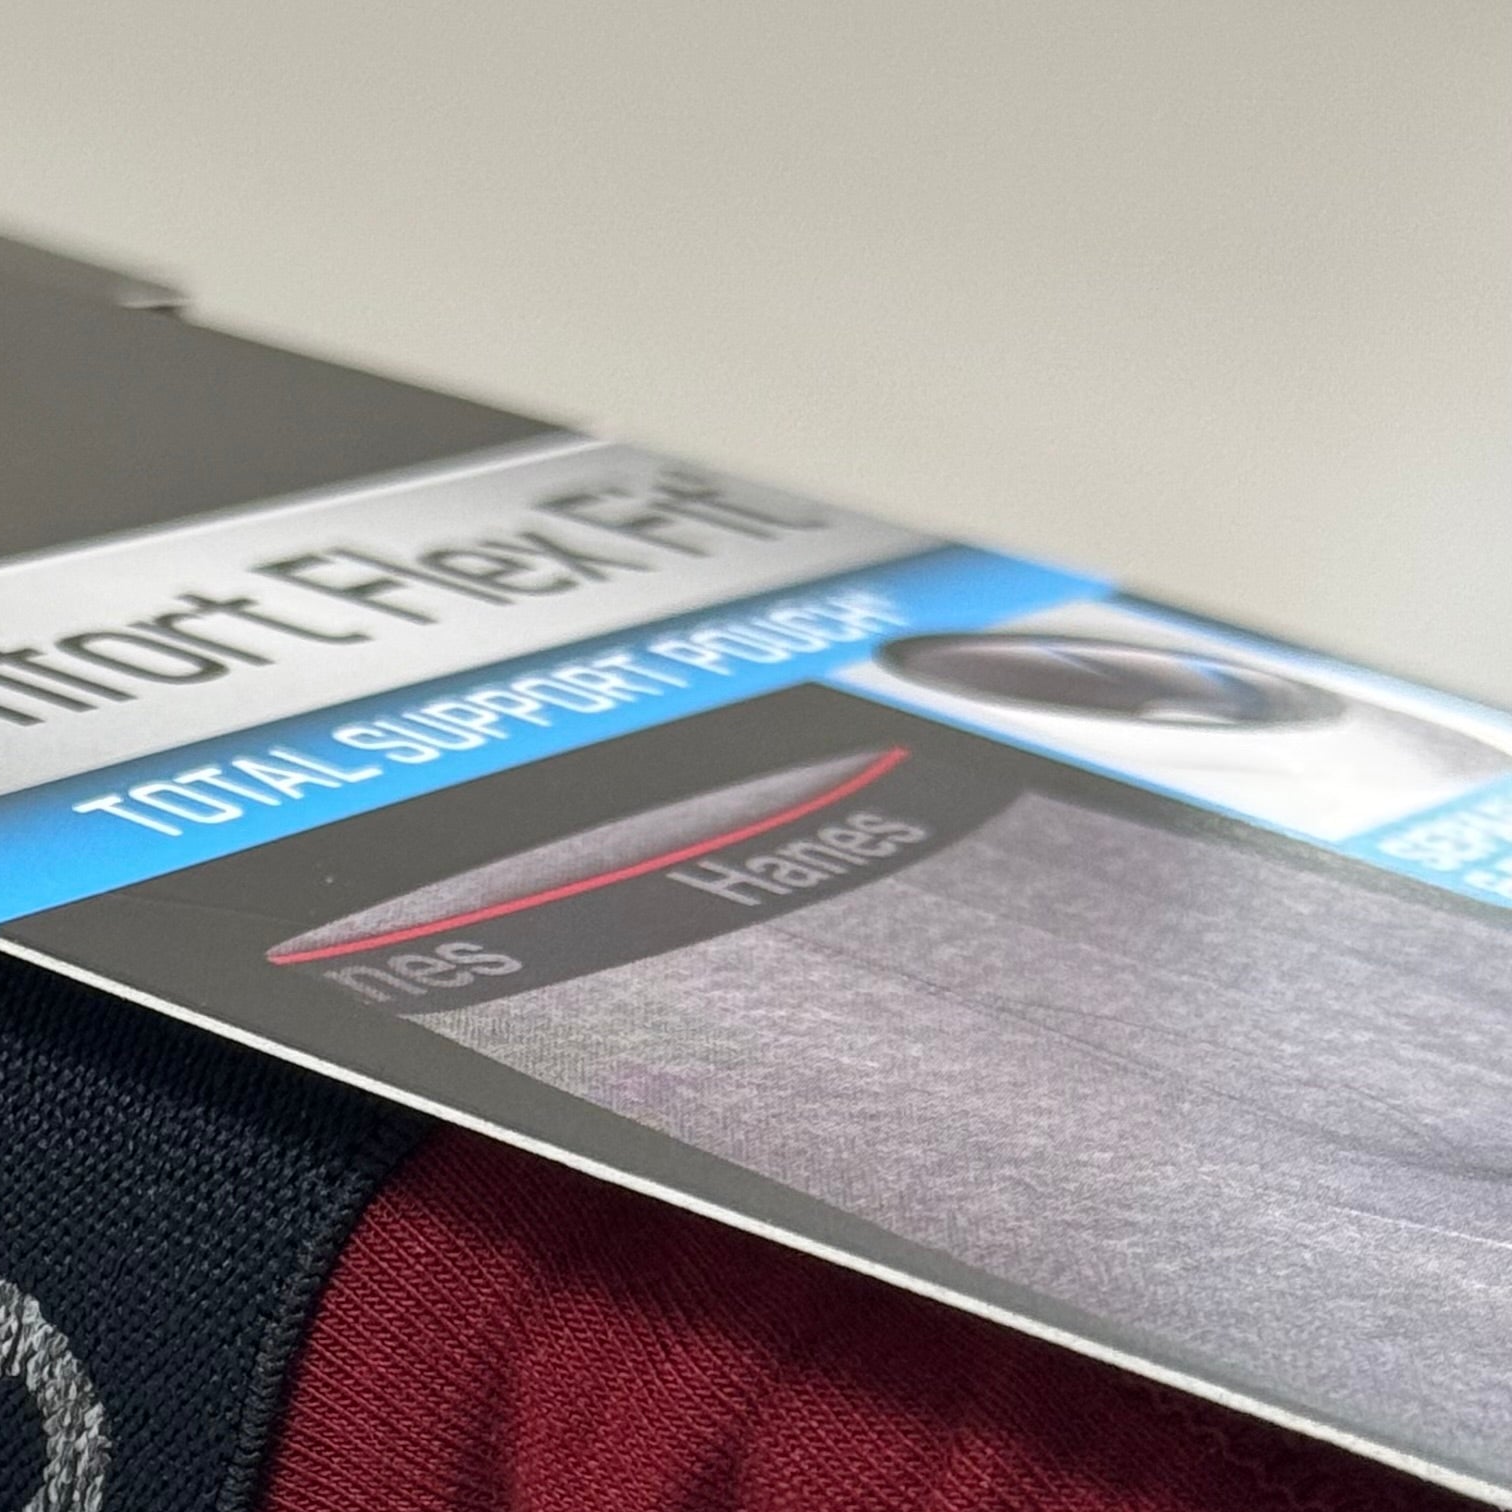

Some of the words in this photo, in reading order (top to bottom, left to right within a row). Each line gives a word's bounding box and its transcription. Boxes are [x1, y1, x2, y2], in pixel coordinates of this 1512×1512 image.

[247, 530, 656, 624] Flex
[532, 467, 831, 558] Fit
[71, 746, 384, 836] TOTAL
[331, 648, 660, 766] SUPPORT
[665, 810, 935, 907] Hanes
